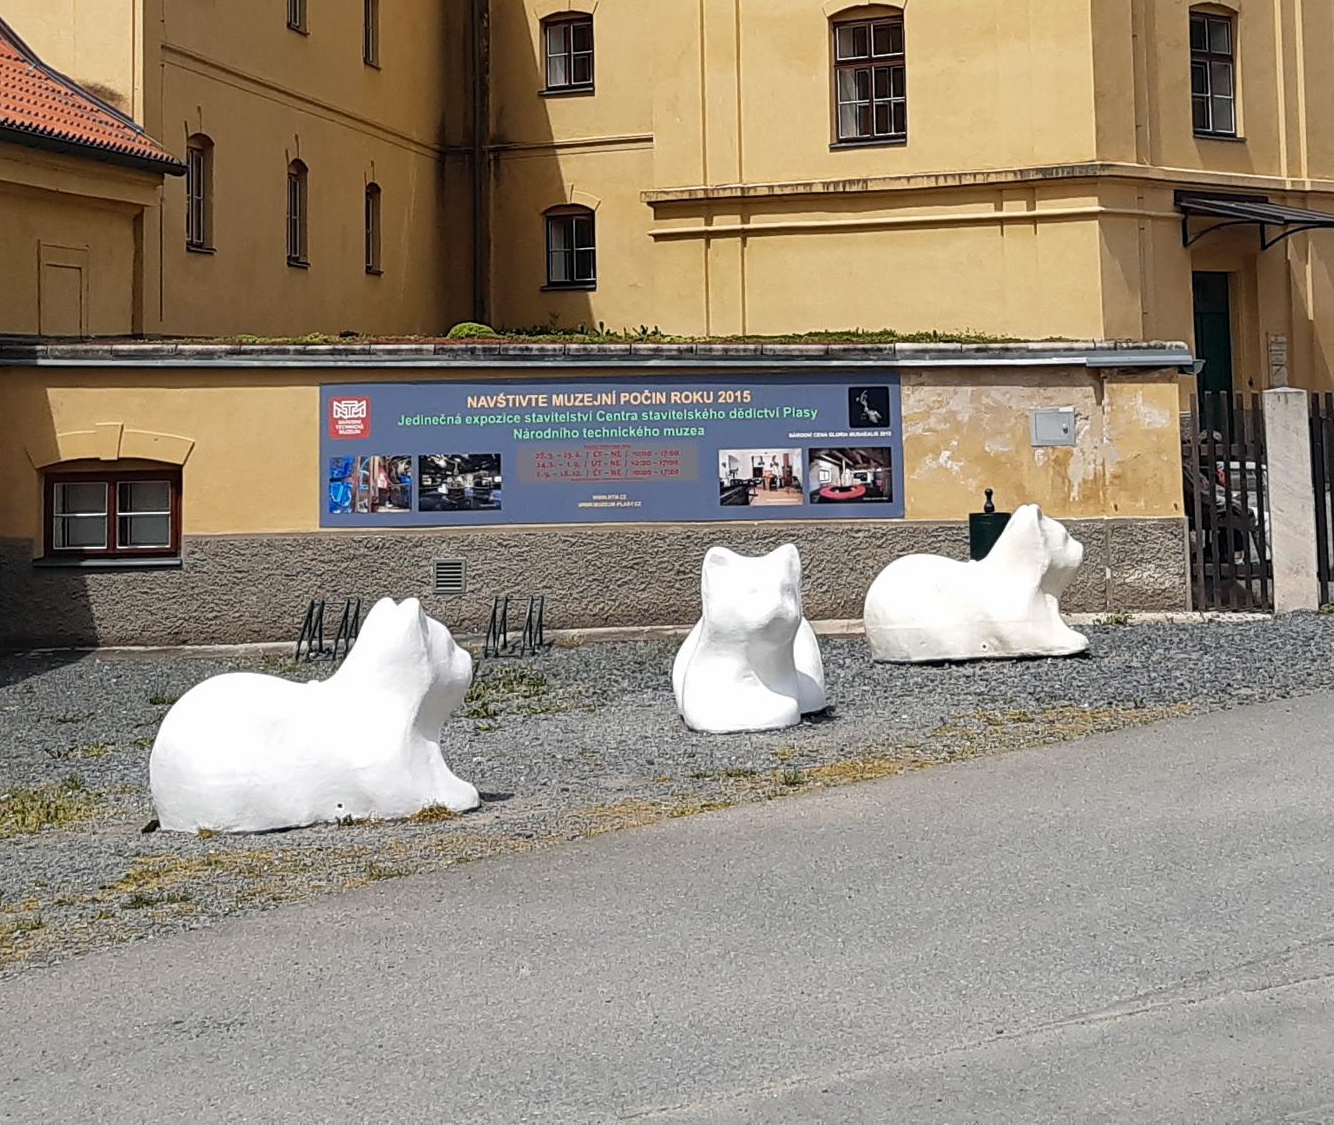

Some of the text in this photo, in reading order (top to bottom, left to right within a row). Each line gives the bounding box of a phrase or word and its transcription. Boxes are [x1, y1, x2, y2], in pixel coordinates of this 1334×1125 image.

[467, 389, 752, 409] NAVŠTIVTE MUZEJNÍ POČIN ROKU 2015
[398, 406, 818, 427] Jedinečná expozice stavitelství Centra stavitelského dědictví Plasy
[513, 425, 705, 440] Národního technického muzea
